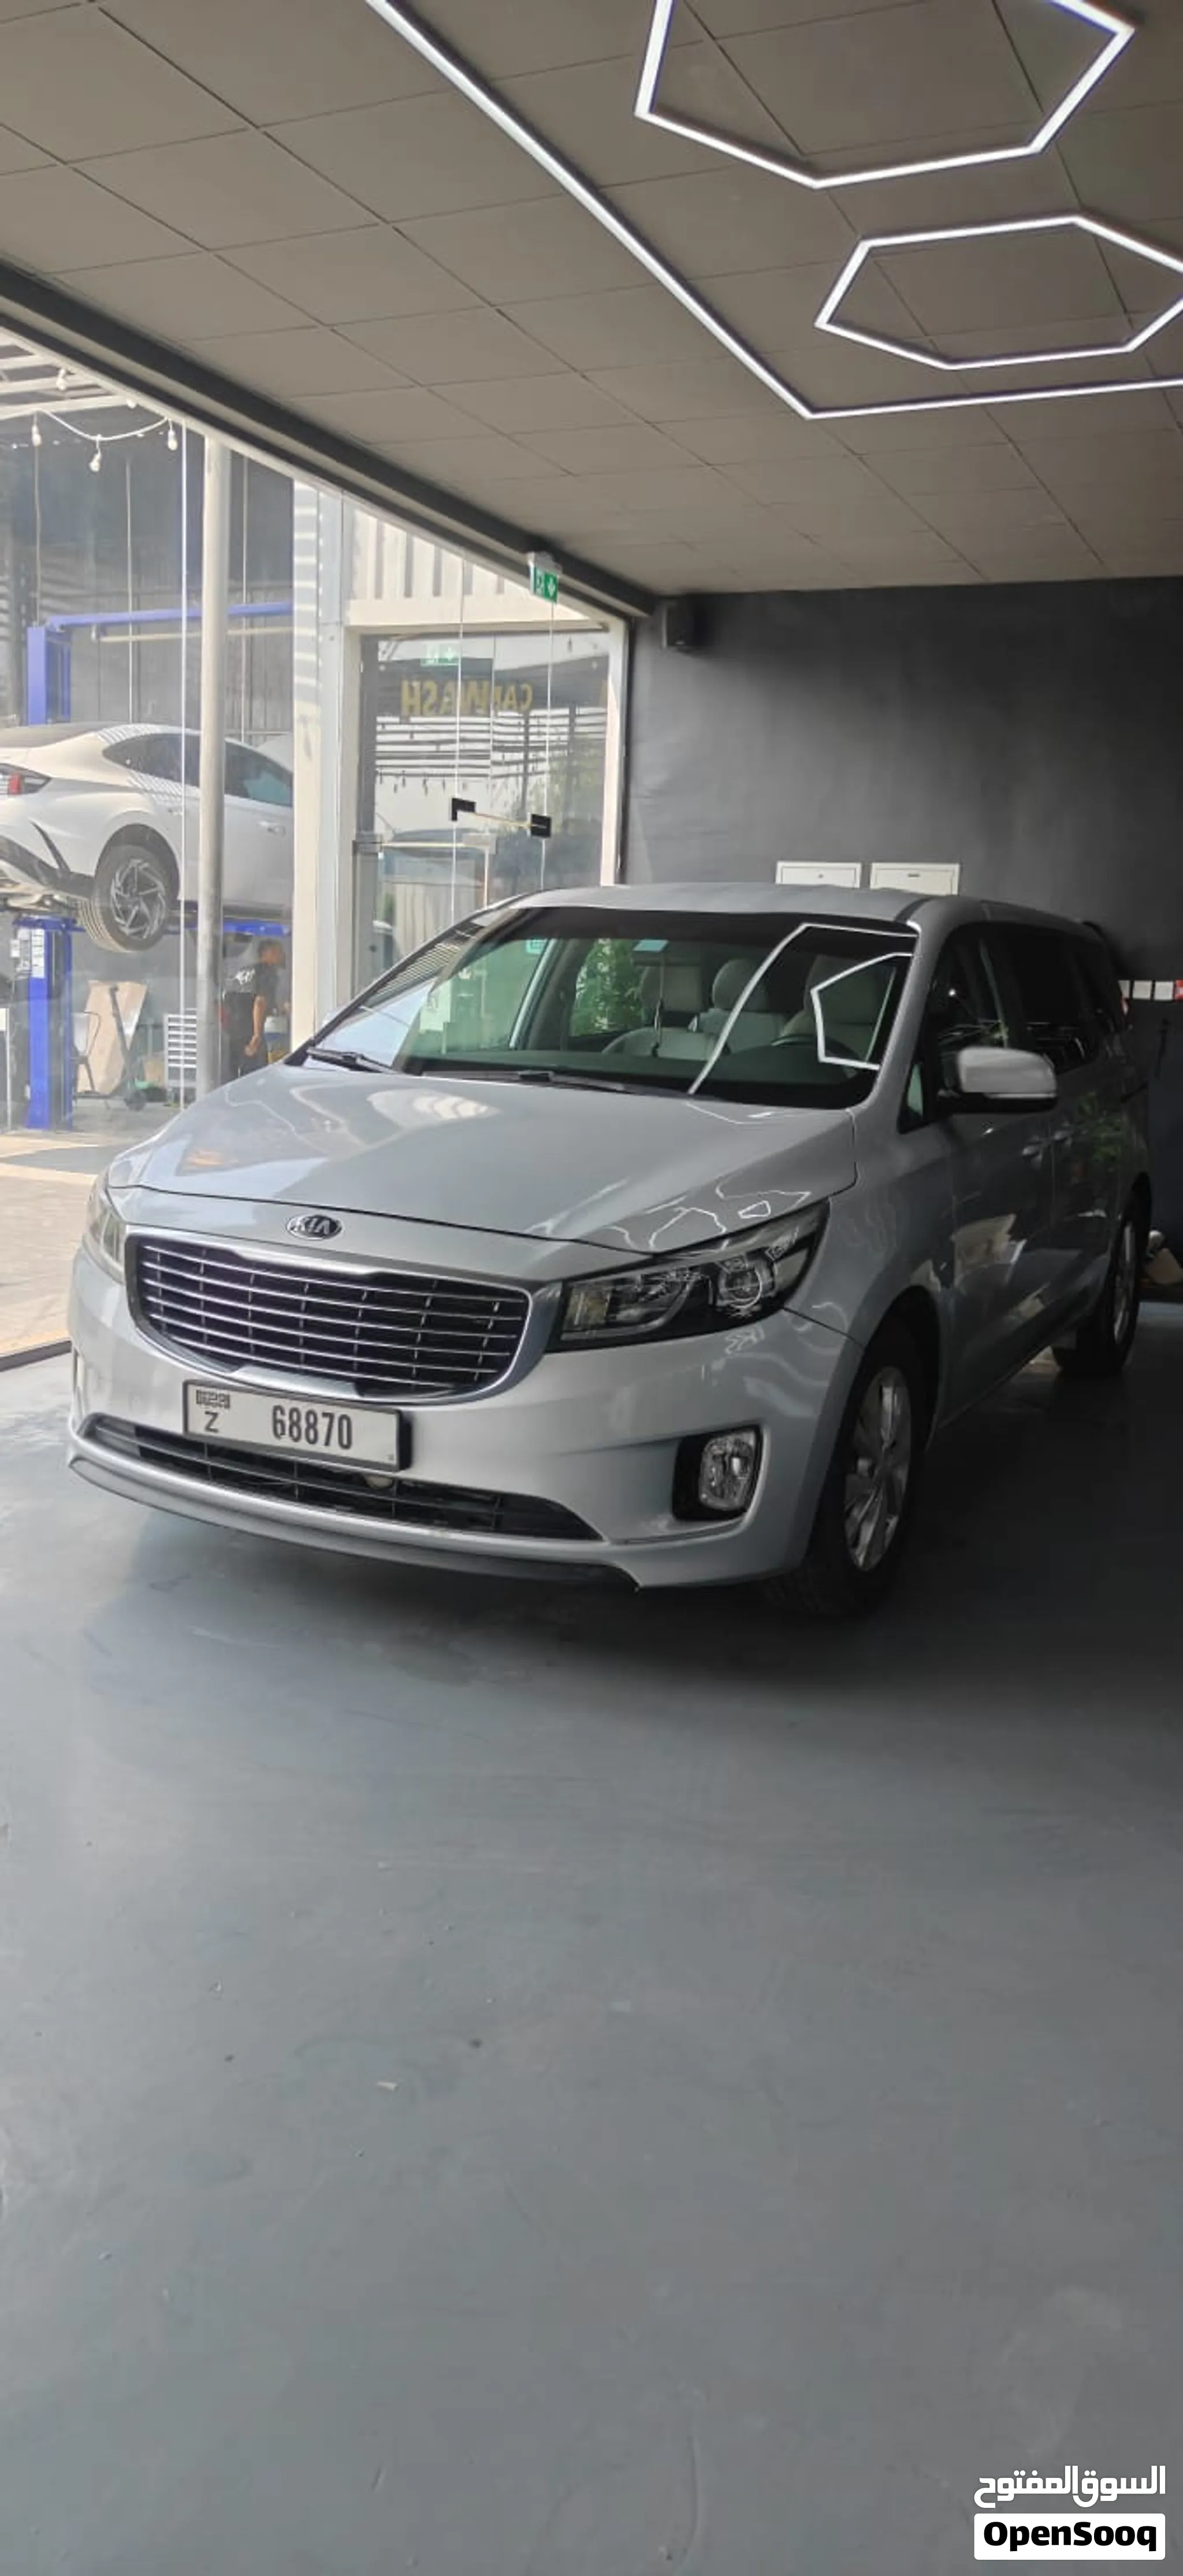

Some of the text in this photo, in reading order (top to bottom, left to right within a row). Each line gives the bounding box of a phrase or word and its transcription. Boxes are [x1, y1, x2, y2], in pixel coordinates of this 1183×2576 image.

[295, 1216, 330, 1235] KIA
[204, 1405, 352, 1449] Z 68870
